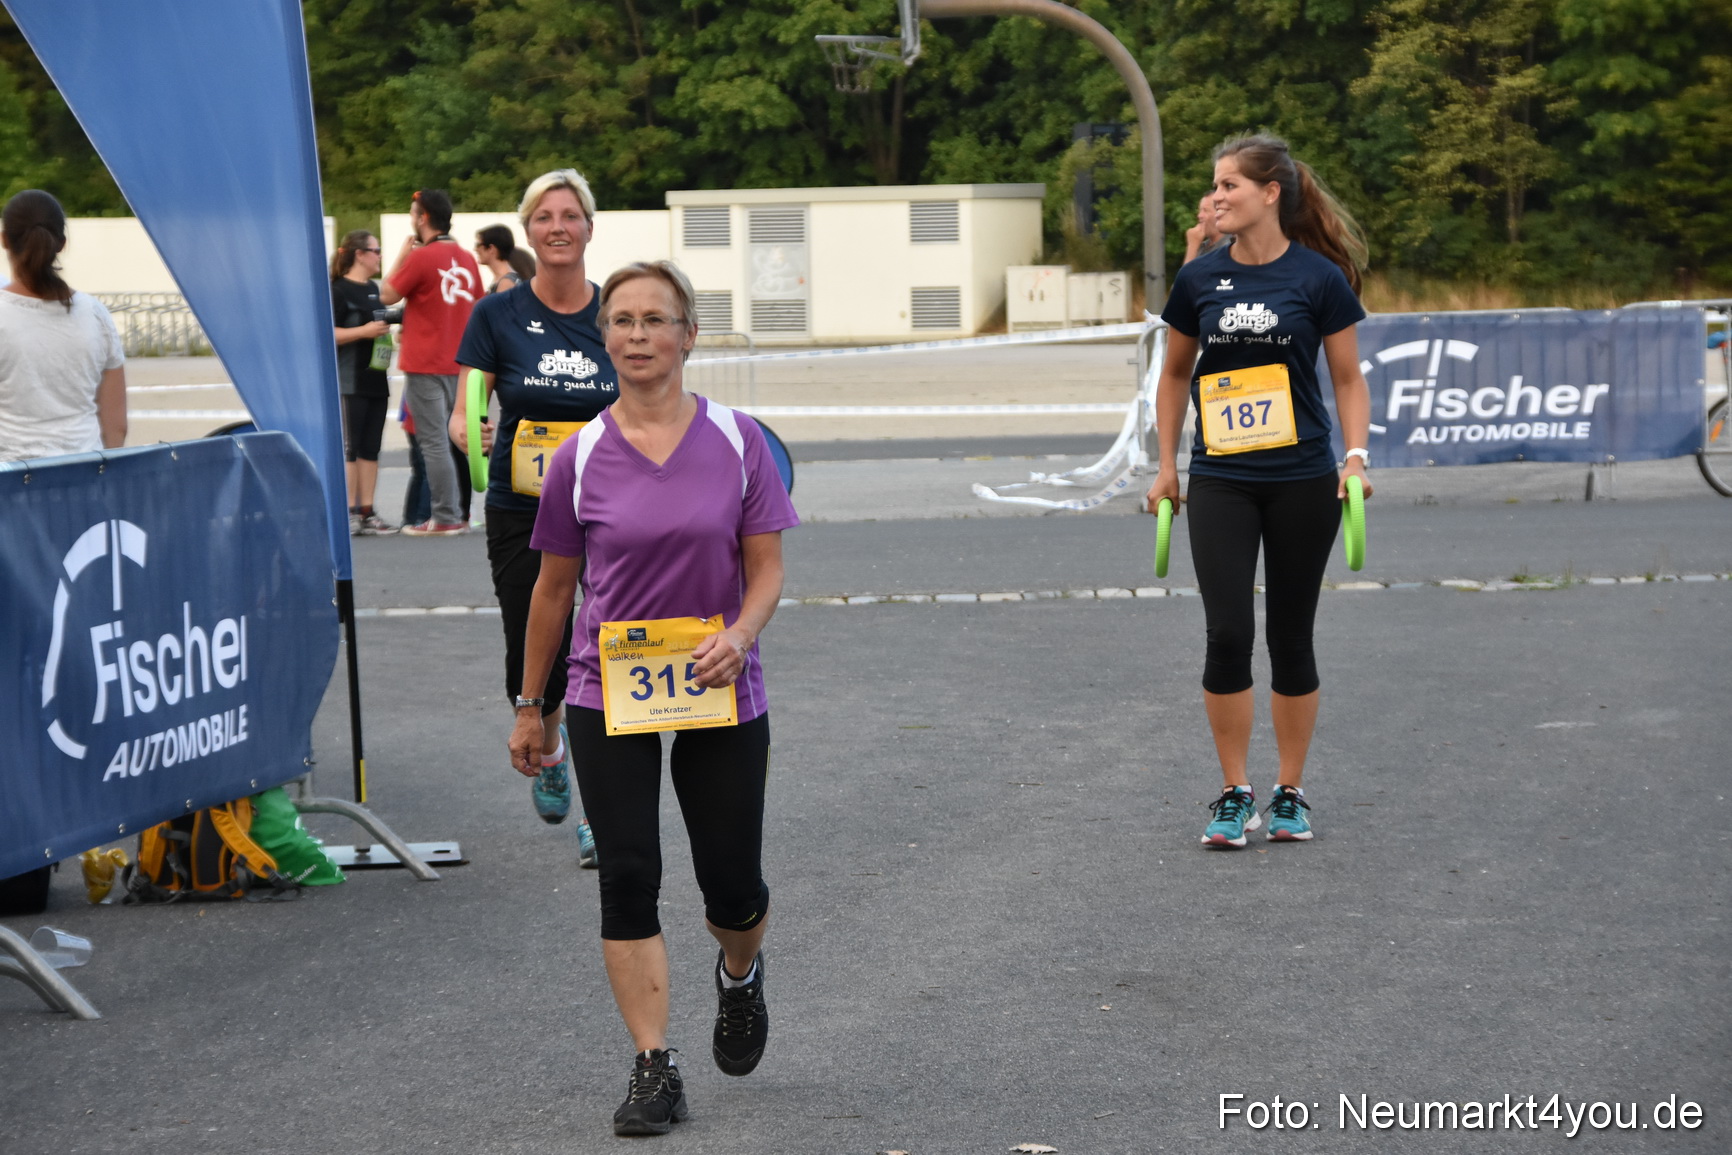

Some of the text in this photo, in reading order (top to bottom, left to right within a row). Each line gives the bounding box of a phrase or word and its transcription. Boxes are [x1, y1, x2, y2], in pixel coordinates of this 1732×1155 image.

[1219, 307, 1278, 333] Burgis
[538, 353, 599, 379] Burgis
[524, 376, 614, 391] Weil's guad is!
[1387, 375, 1610, 420] Fischer
[1221, 400, 1272, 430] 187
[1407, 421, 1591, 444] AUTOMOBILE
[629, 662, 708, 702] 315
[649, 705, 692, 716] Ute Kratzer
[102, 703, 248, 782] AUTOMOBILE
